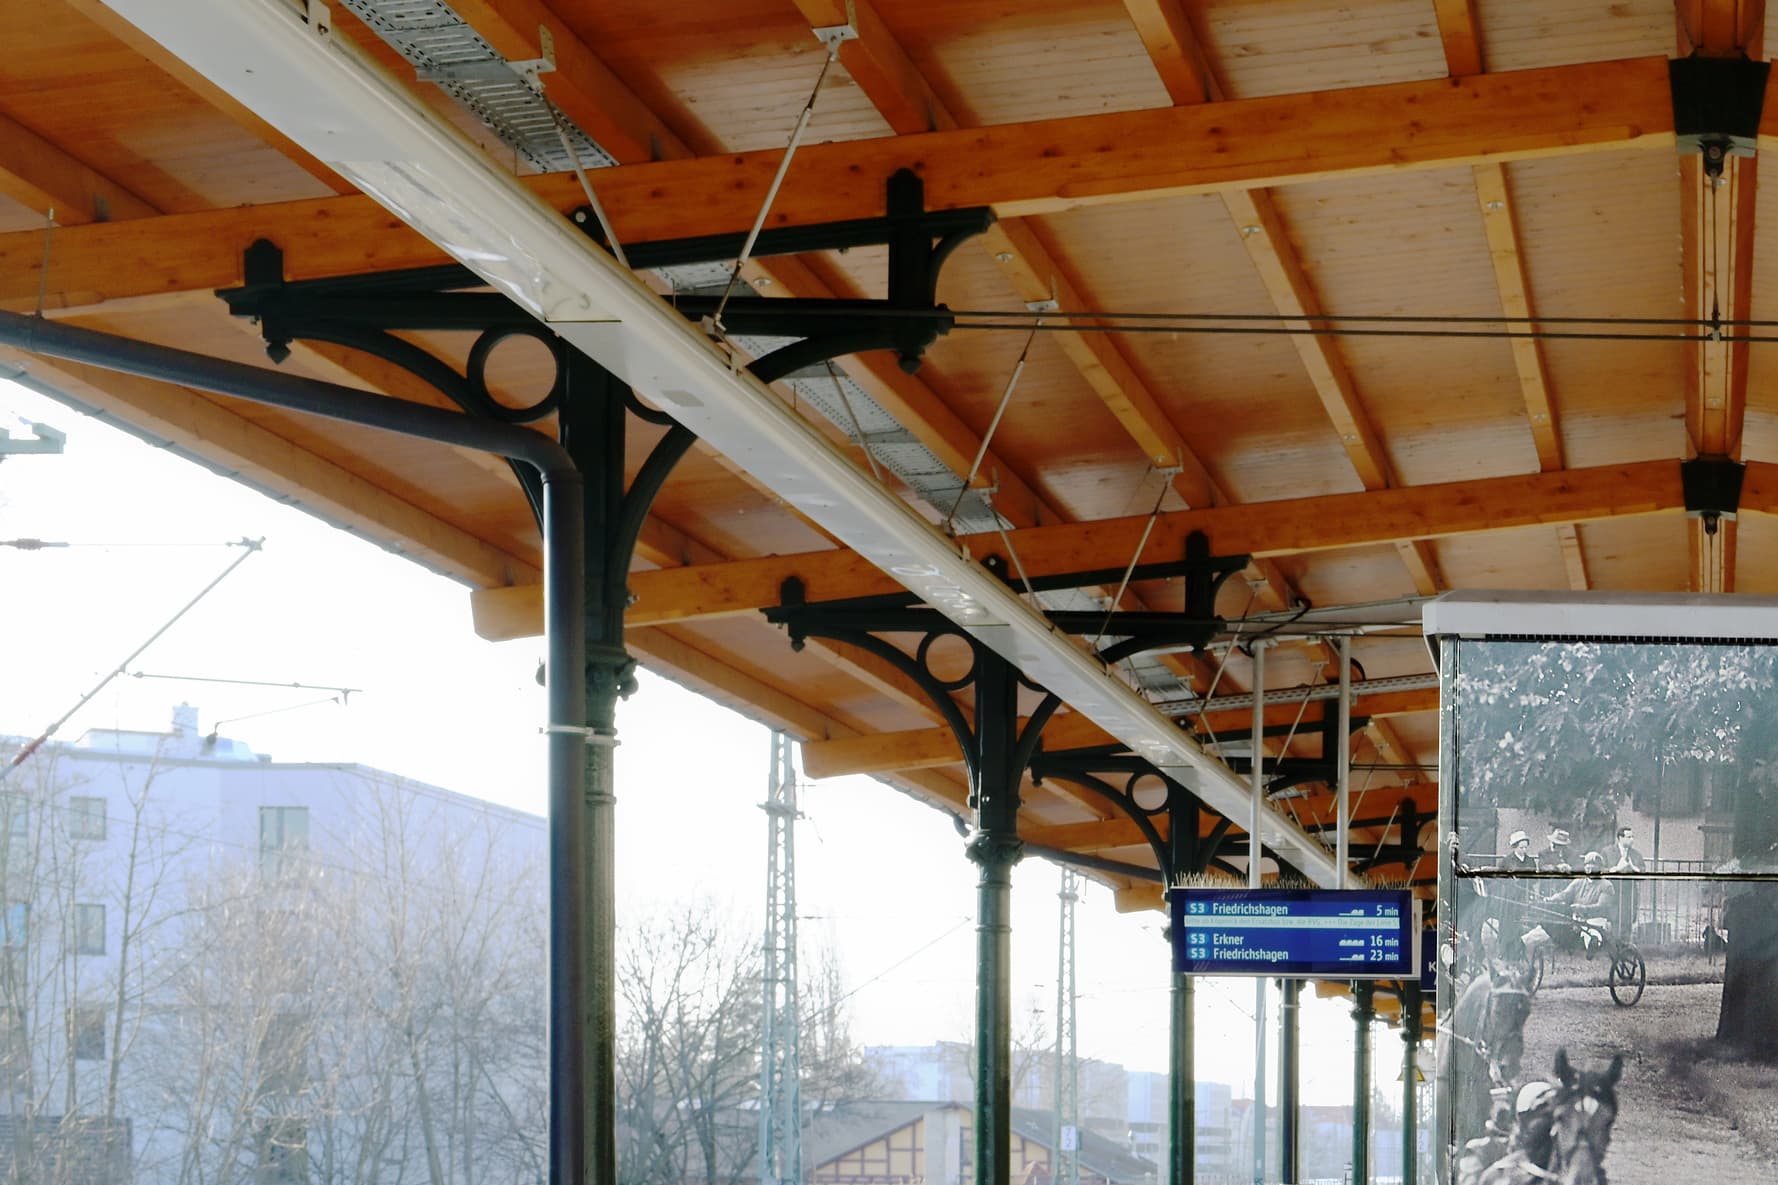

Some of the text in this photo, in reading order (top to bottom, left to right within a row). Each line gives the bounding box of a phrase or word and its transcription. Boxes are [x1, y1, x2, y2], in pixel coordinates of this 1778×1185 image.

[1190, 902, 1399, 917] S3 Friedrichshagen 5 min
[1191, 932, 1399, 947] S3 Erkner 16 min
[1191, 947, 1399, 962] S3 Friedrichshagen 23 min
